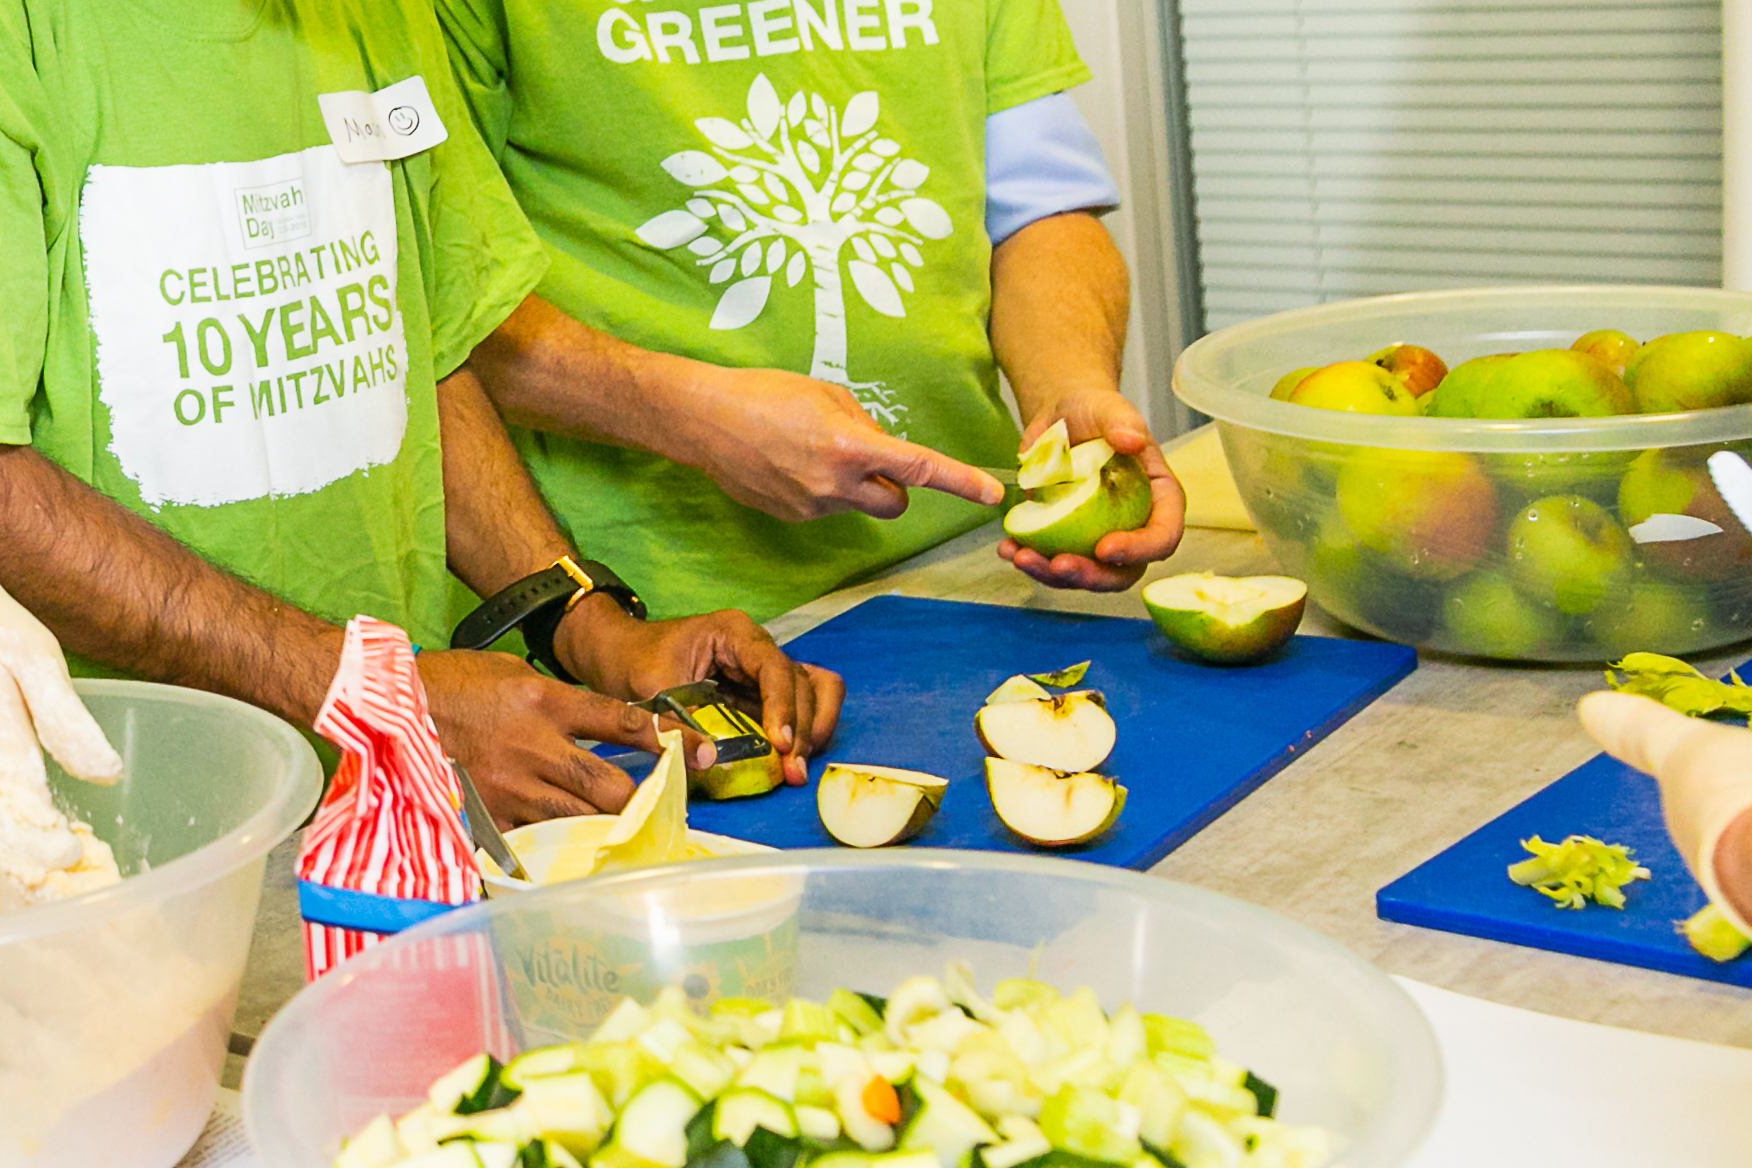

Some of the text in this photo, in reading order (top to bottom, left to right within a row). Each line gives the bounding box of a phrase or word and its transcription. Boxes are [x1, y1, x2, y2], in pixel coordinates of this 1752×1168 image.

[242, 185, 304, 215] Mitzvah
[246, 217, 275, 240] Day
[158, 230, 380, 307] CELEBRATING
[162, 273, 393, 380] 10 YEARS
[173, 343, 398, 426] OF MITZVAHS
